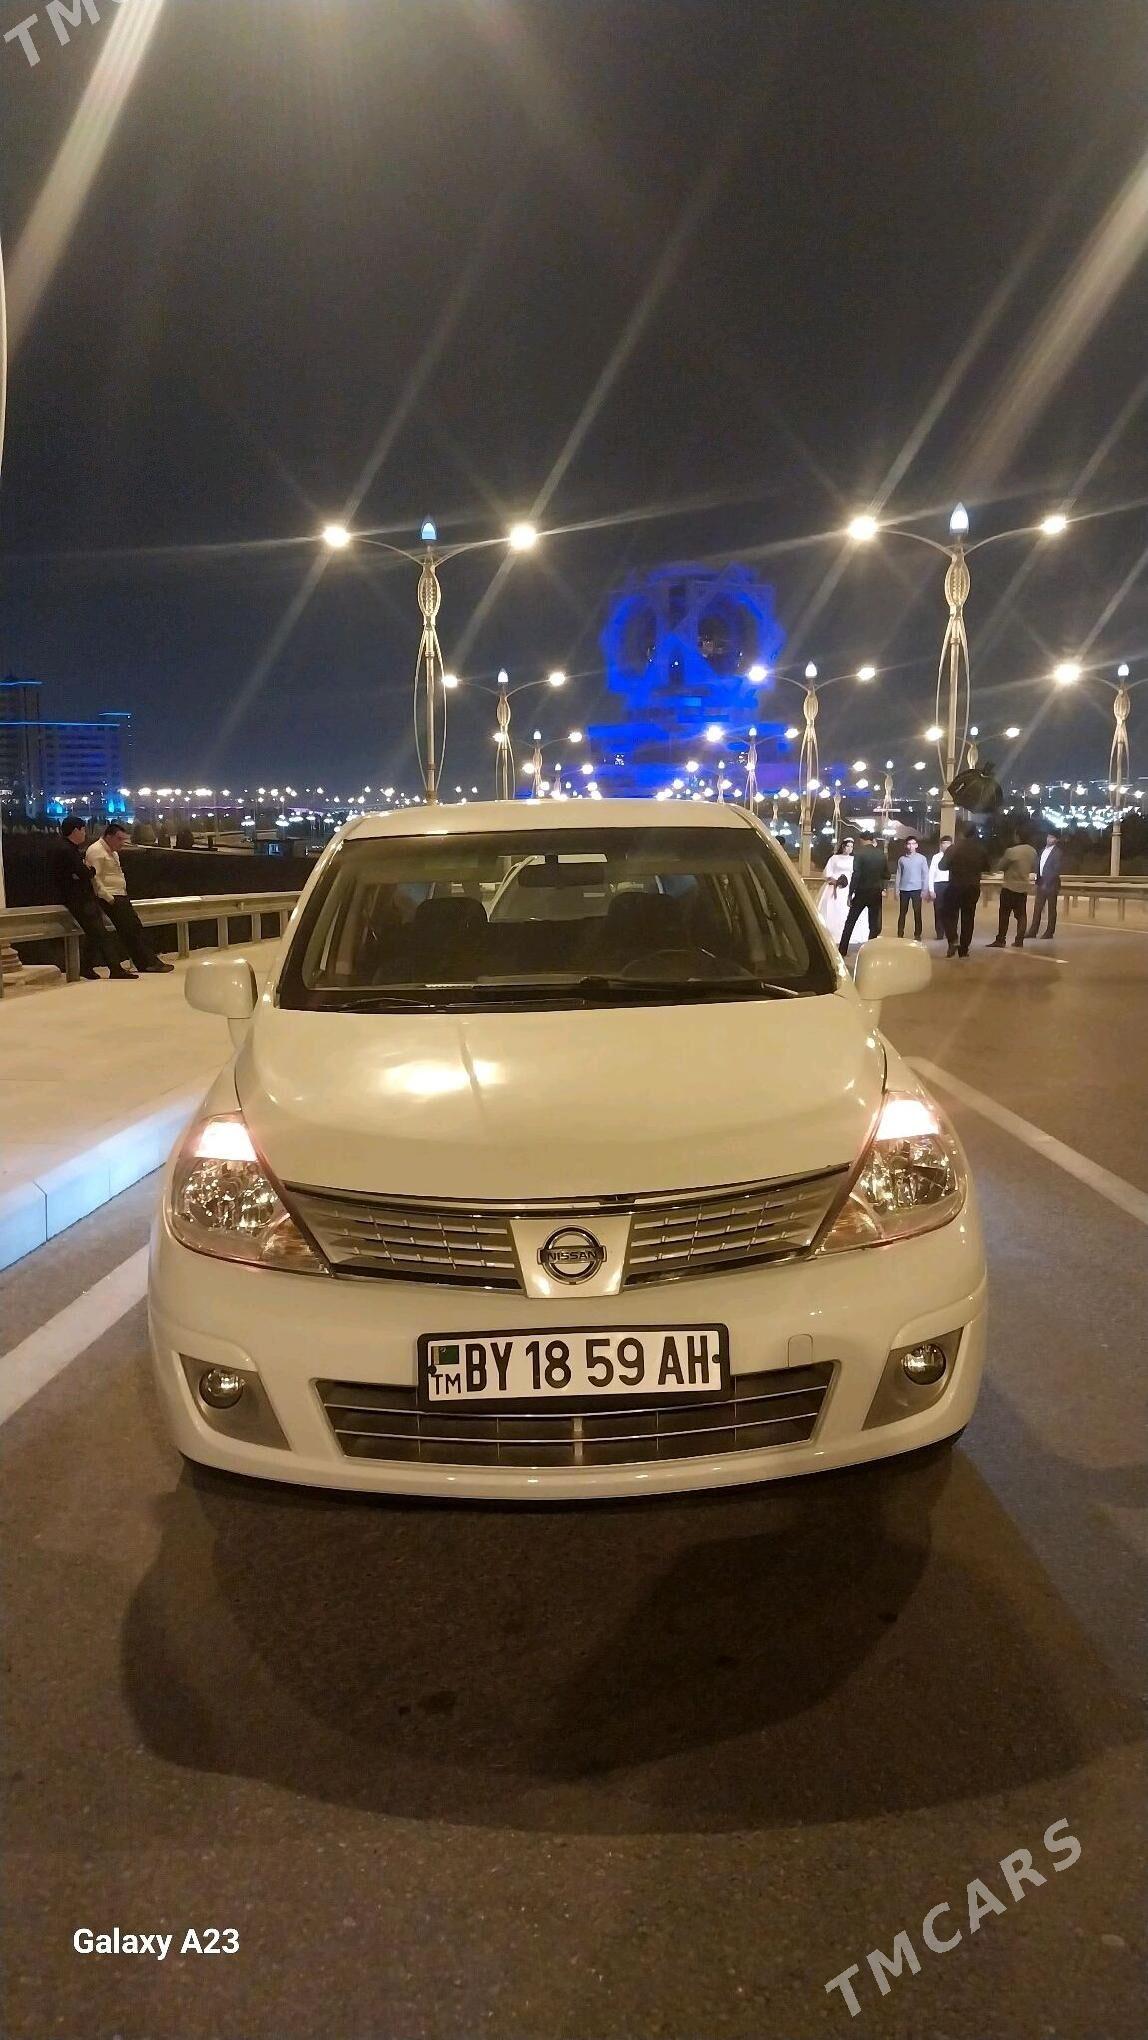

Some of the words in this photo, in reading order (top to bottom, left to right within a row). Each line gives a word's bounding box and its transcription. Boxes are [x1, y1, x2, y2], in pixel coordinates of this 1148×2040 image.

[547, 1250, 597, 1261] NISSAN
[465, 1342, 513, 1392] BY
[525, 1340, 571, 1389] 18
[586, 1337, 645, 1388] 59
[657, 1335, 710, 1385] AH
[433, 1373, 462, 1395] TM
